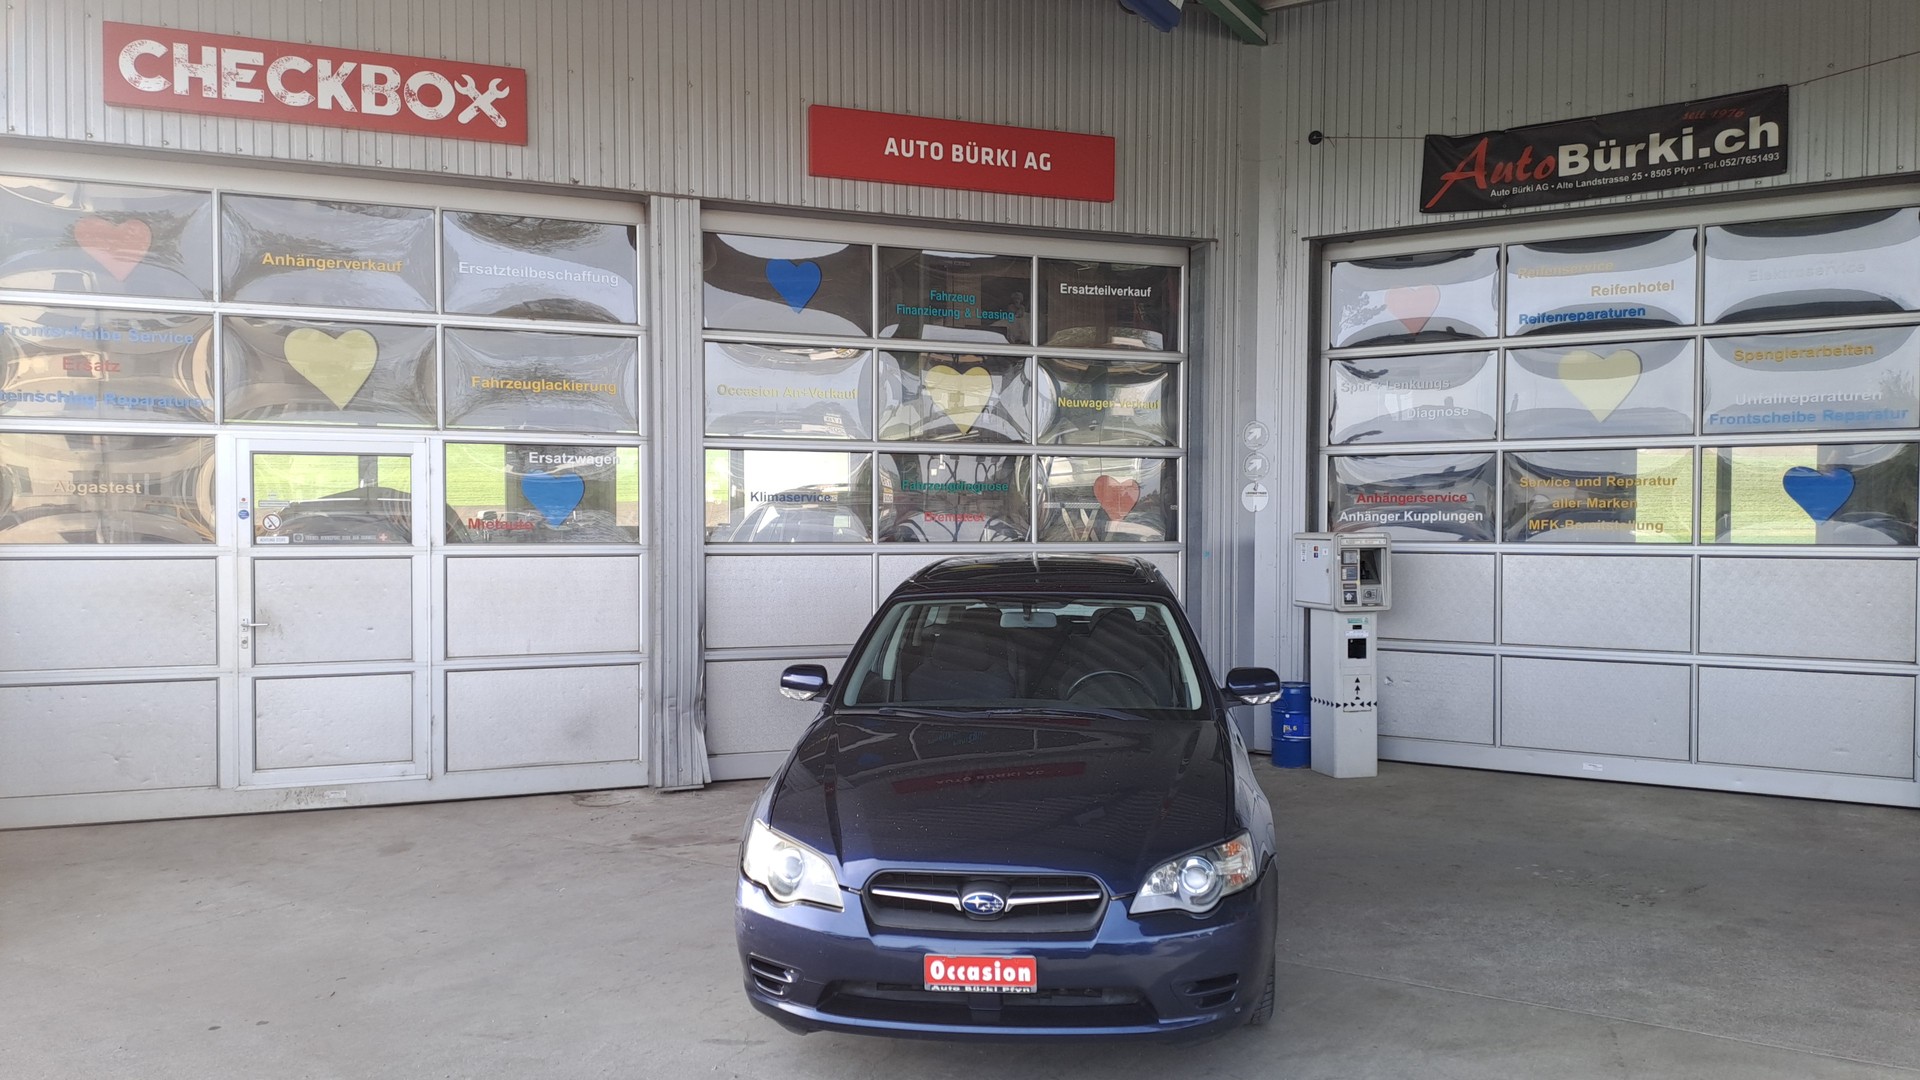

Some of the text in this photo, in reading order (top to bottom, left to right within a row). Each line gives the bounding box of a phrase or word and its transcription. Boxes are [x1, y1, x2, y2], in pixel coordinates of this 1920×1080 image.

[118, 39, 510, 128] CHECKBOX
[1711, 107, 1745, 119] 1976
[884, 137, 1051, 171] AUTO BÜRKI AG
[1490, 188, 1510, 197] Auto
[1512, 183, 1534, 194] Bürki
[1535, 183, 1549, 192] AG
[1556, 181, 1573, 190] Alte
[1576, 174, 1630, 188] Landstrasse
[1631, 172, 1643, 181] 25
[1650, 169, 1672, 178] 8505
[1674, 166, 1695, 176] Pfyn
[262, 252, 402, 274] Anhängerverkauf
[1517, 261, 1615, 280] Reifenservice
[458, 261, 620, 287] Ersatzteilbeschaffung
[930, 289, 976, 304] Fahrzeug
[1060, 283, 1152, 298] Ersatzteilverkauf
[1591, 280, 1675, 297] Reifenhotel
[896, 304, 1015, 322] Finanzierung & Leasing
[1519, 306, 1646, 326] Reifenreparaturen
[128, 328, 194, 344] Service
[1734, 343, 1875, 364] Spenglerarbeiten
[63, 356, 120, 373] Ersatz
[471, 375, 617, 396] Fahrzeuglackierung
[717, 384, 779, 397] Occasion
[1341, 380, 1372, 395] Spur
[1386, 378, 1450, 391] Lenkungs
[0, 388, 98, 410] teinschlag
[1736, 389, 1883, 407] Unfallreparaturen
[1407, 407, 1469, 420] Diagnose
[1709, 408, 1910, 426] Frontscheibe Reparatur
[529, 451, 621, 467] Ersatzwagen
[53, 480, 142, 496] Abgastest
[902, 480, 1009, 493] Fahrzeugdiagnose
[1519, 475, 1677, 490] Service und Reparatur
[750, 491, 831, 503] Klimaservice
[1356, 492, 1468, 505] Anhängerservice
[1552, 497, 1638, 508] aller Marken
[1338, 510, 1483, 525] Anhänger Kupplungen
[1529, 519, 1664, 534] MFK-Bereitstellung
[930, 960, 1031, 982] Occasion
